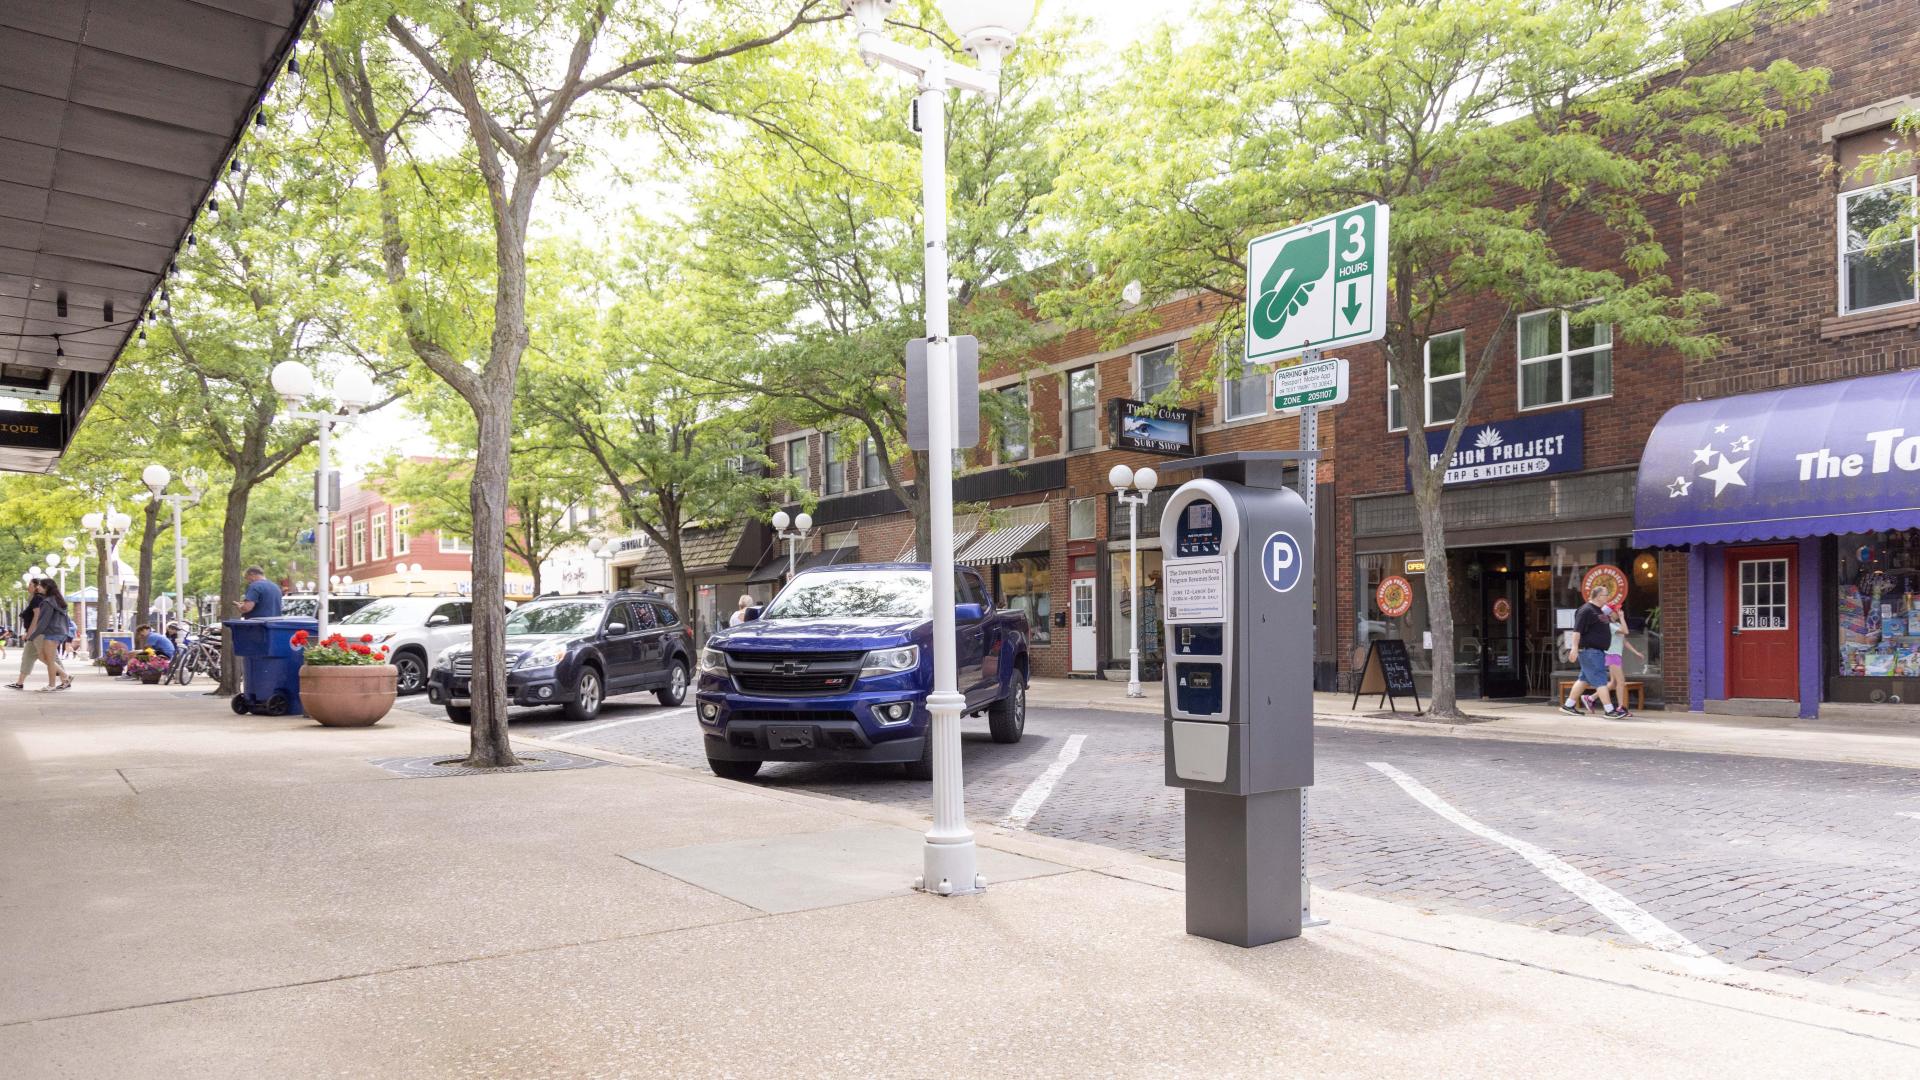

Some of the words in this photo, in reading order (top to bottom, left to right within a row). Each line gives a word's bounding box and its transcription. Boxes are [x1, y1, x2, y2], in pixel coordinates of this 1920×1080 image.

[1341, 214, 1366, 262] 3
[1340, 260, 1368, 278] HOURS
[1278, 370, 1302, 380] PARKING
[1309, 363, 1334, 373] PAYMENTS
[1283, 396, 1302, 406] ZONE
[1158, 408, 1186, 420] COAST
[0, 424, 39, 434] IQUE
[1134, 438, 1156, 448] SURF
[1158, 441, 1180, 451] SHOP
[1430, 448, 1485, 470] ASION
[1492, 434, 1564, 460] PROJECT
[1448, 470, 1466, 480] TAP
[1486, 462, 1533, 476] KITCHEN
[1796, 448, 1864, 480] The
[1274, 542, 1293, 581] P
[1408, 562, 1425, 570] OPEN
